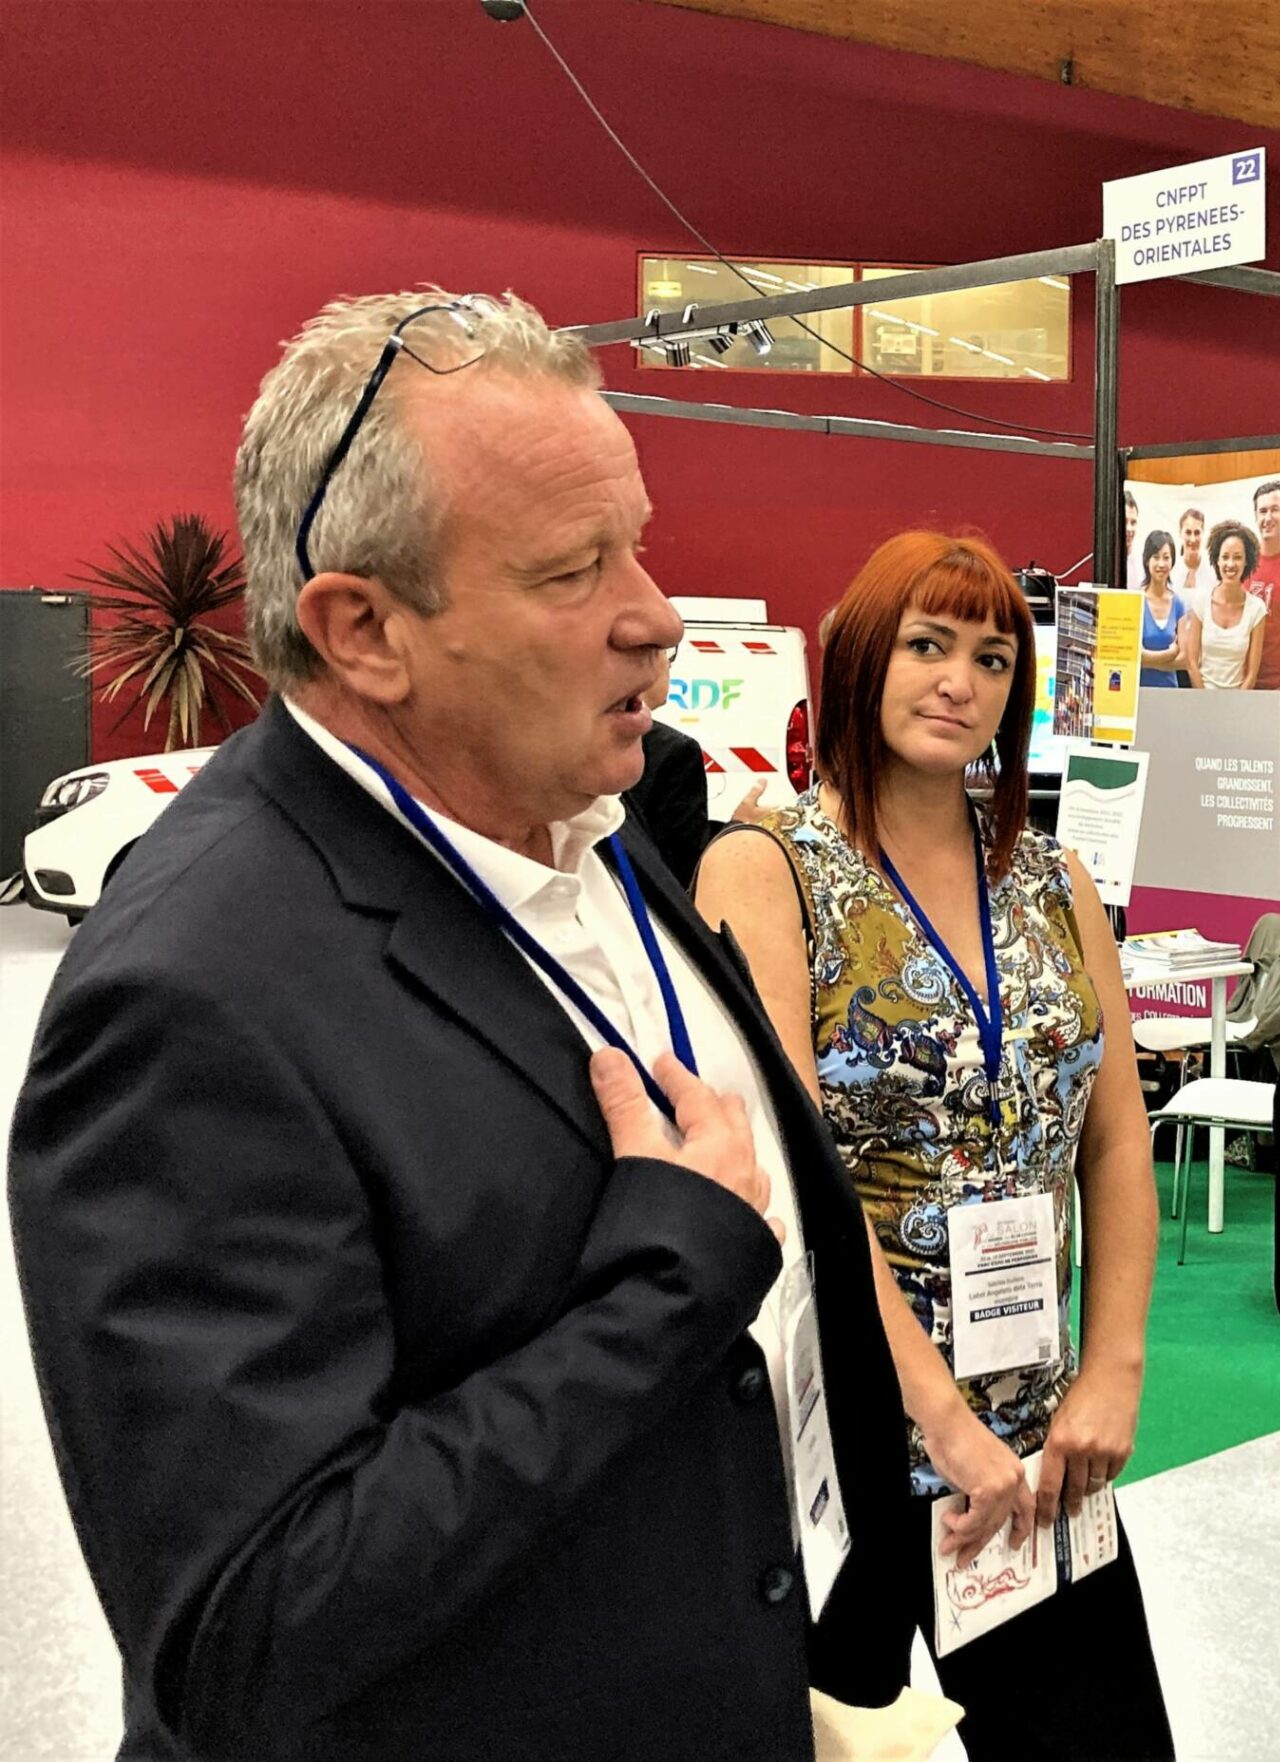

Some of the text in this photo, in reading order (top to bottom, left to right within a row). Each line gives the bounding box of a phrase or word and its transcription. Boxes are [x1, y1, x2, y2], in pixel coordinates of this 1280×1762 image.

[1236, 158, 1256, 180] 22
[1156, 182, 1208, 208] CNFPT
[1121, 204, 1245, 242] DES PYRENEES-
[1133, 233, 1232, 266] ORIENTALES
[1195, 756, 1274, 774] QUAND LES TALENTS
[1200, 794, 1215, 808] LES
[1217, 814, 1274, 831] PROGRESSENT
[974, 1301, 1040, 1320] BADGE VISITEUR
